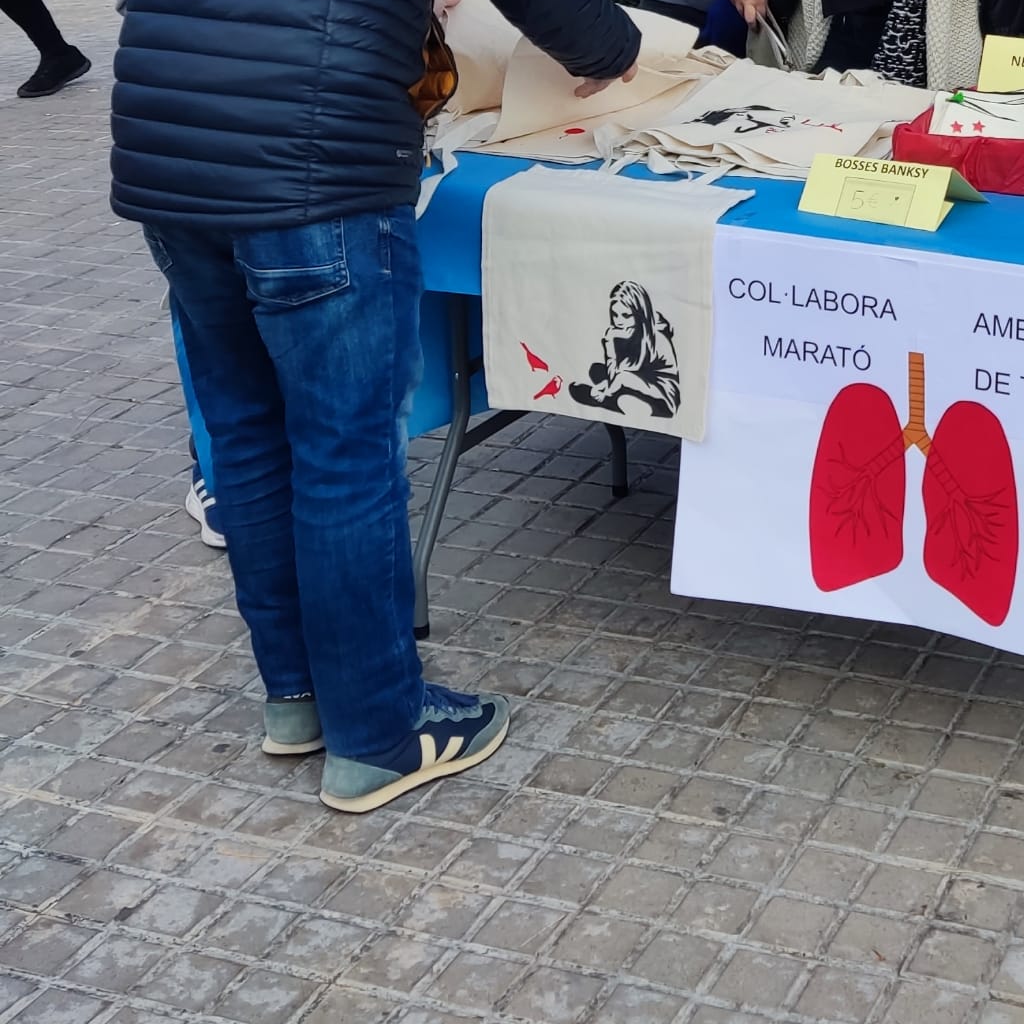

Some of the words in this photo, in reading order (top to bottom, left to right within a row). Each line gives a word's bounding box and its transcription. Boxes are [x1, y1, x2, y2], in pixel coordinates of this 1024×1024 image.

[835, 158, 878, 173] BOSSES
[881, 163, 929, 179] BANKSY
[728, 277, 898, 322] COL·LABORA
[763, 335, 872, 371] MARATÓ
[974, 368, 1011, 396] DE
